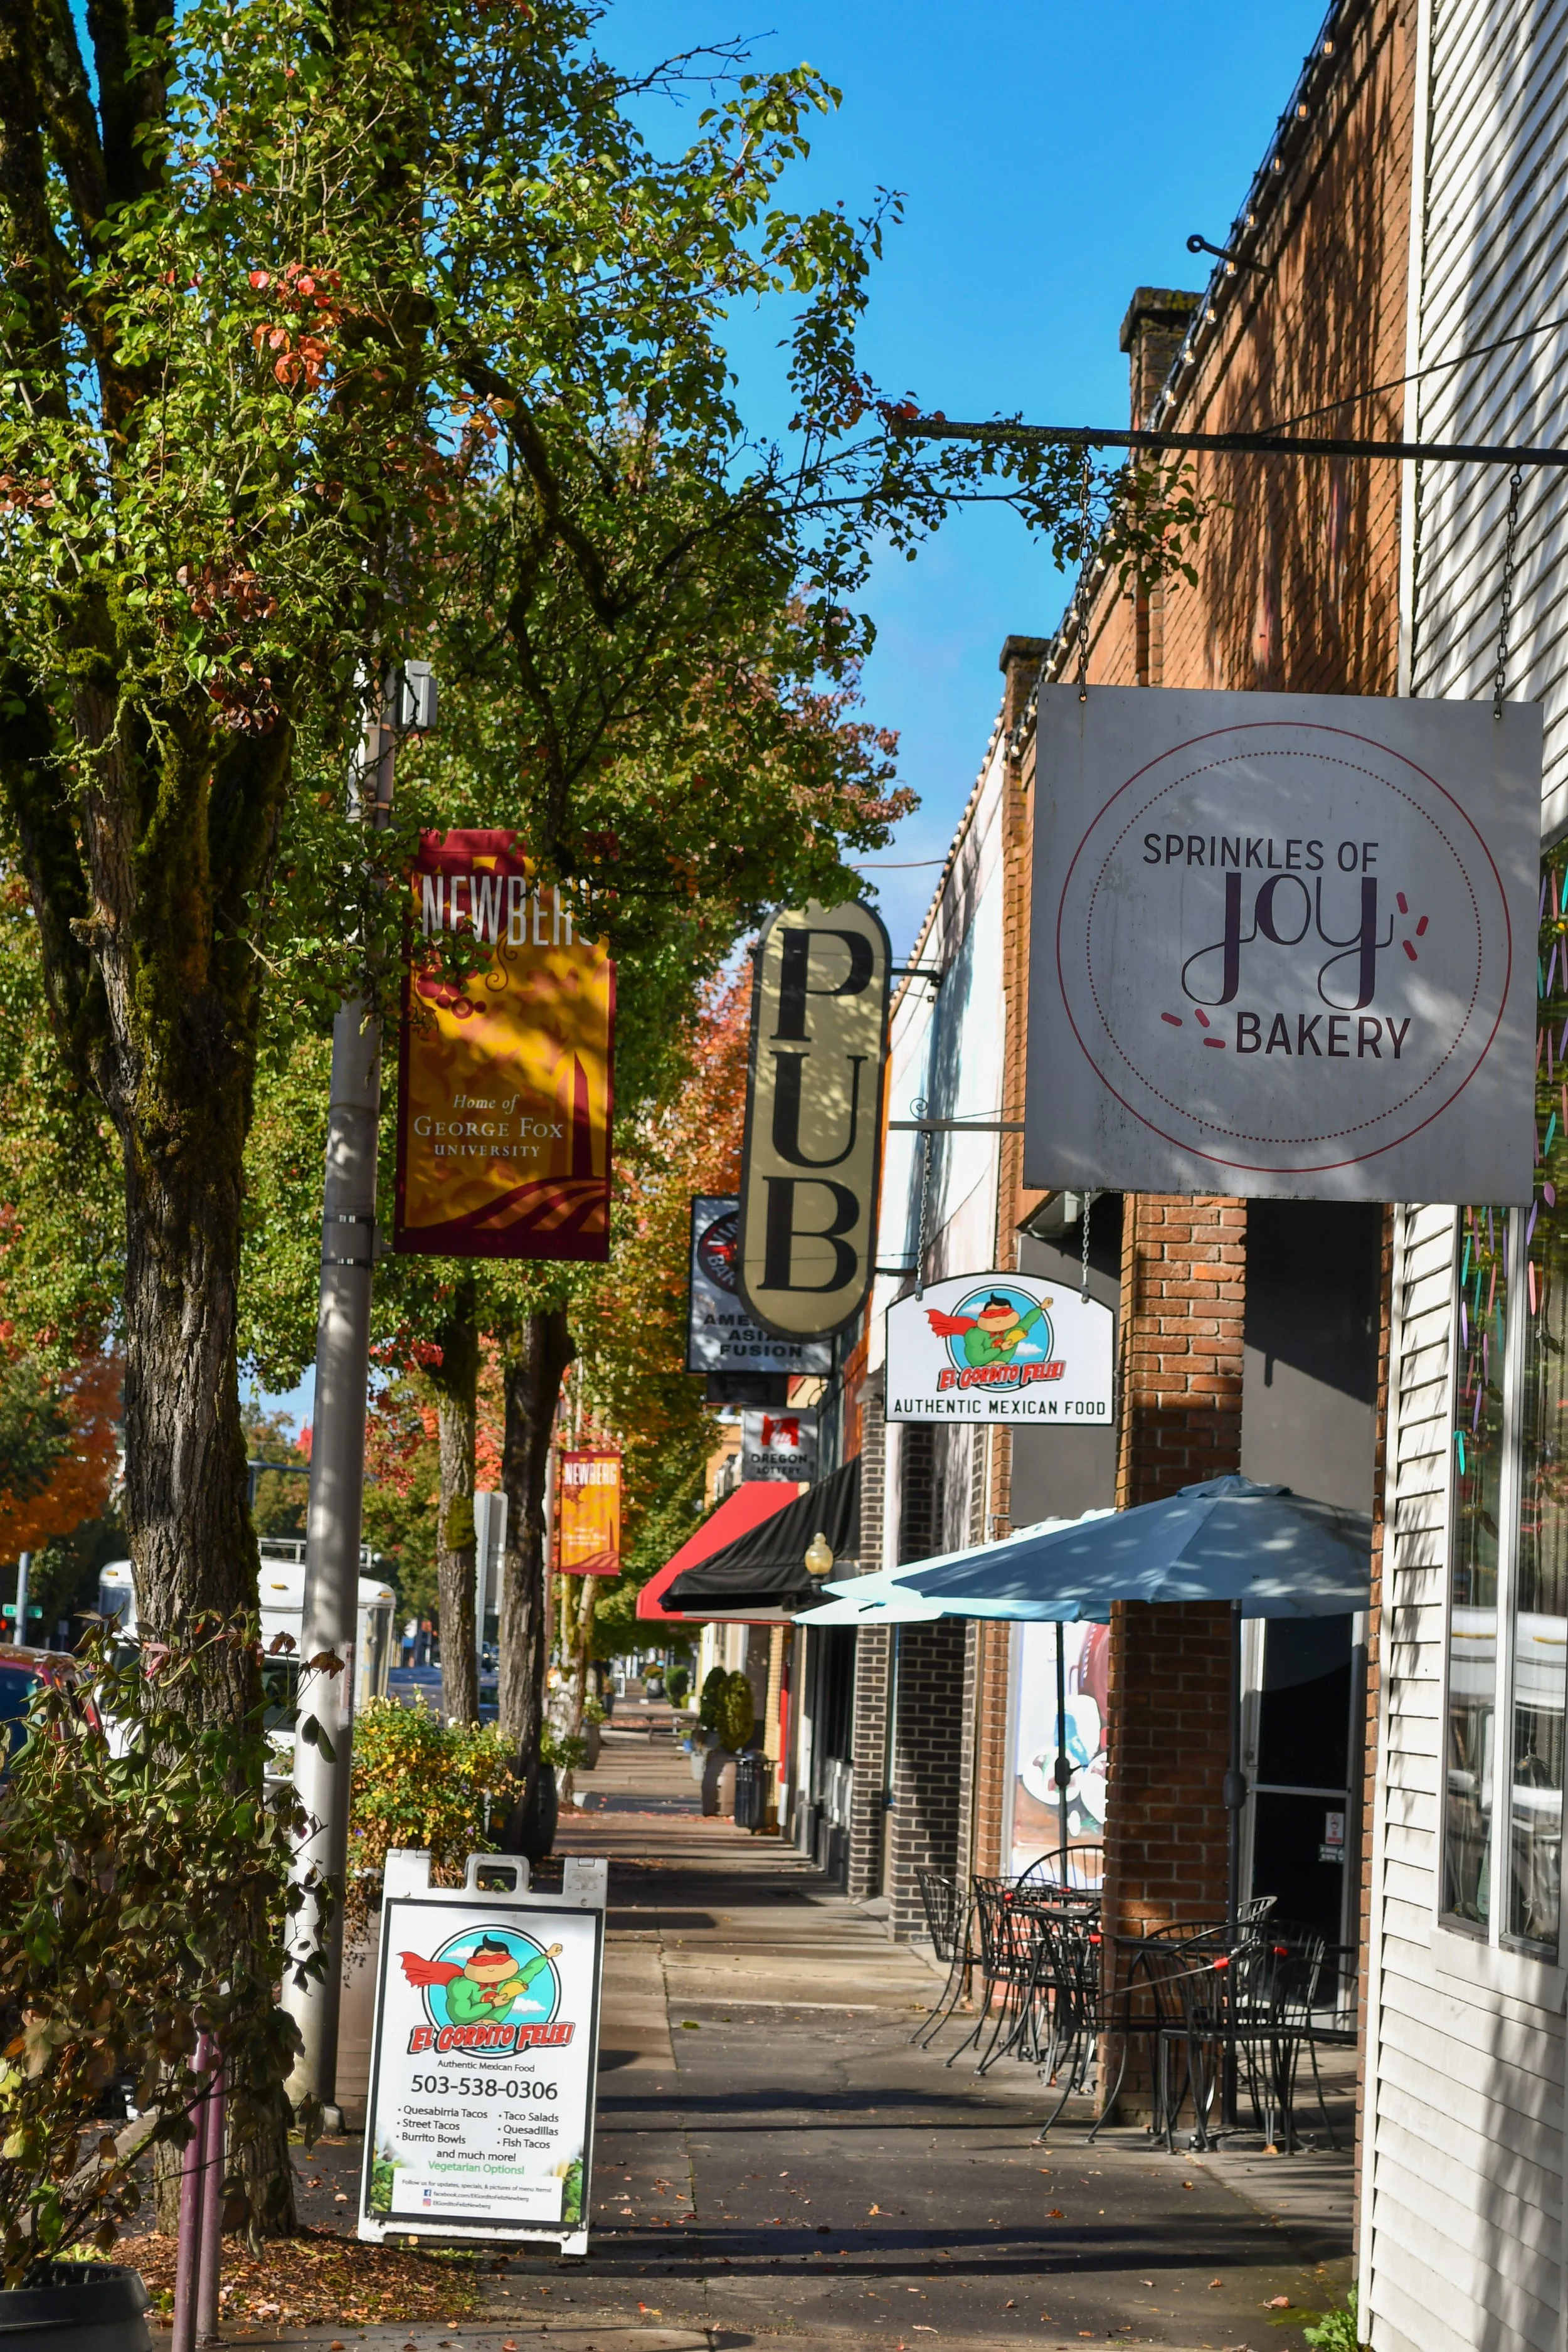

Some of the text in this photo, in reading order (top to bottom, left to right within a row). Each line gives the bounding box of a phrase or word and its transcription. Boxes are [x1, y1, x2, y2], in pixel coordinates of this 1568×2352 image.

[1143, 833, 1379, 872] SPRINKLES OF
[1236, 1011, 1411, 1059] BAKERY
[452, 1094, 519, 1114] Home of
[756, 927, 874, 1293] PUB
[434, 1144, 541, 1158] UNIVERSITY
[720, 1344, 802, 1357] FUSION
[938, 1367, 957, 1391] EL
[959, 1364, 1020, 1390] GORDITO
[894, 1399, 1106, 1416] AUTHENTIC MEXICAN FOOD
[751, 1453, 808, 1464] OREGON
[565, 1463, 617, 1485] NEWBERG
[408, 2025, 435, 2053] EL
[437, 2023, 516, 2052] GORDITO
[437, 2060, 535, 2072] Authentic Mexican Food
[411, 2075, 558, 2100] 503-538-0306
[403, 2105, 488, 2119] Quesabirria Tacos
[504, 2111, 559, 2122] Taco Salads
[402, 2119, 460, 2131] Street Tacos
[503, 2124, 559, 2136] Quesadillas
[401, 2132, 467, 2144] Burrito Bowls
[502, 2138, 551, 2149] Fish Tacos
[437, 2149, 516, 2162] and much more!
[428, 2161, 524, 2175] Vegetarian Options!
